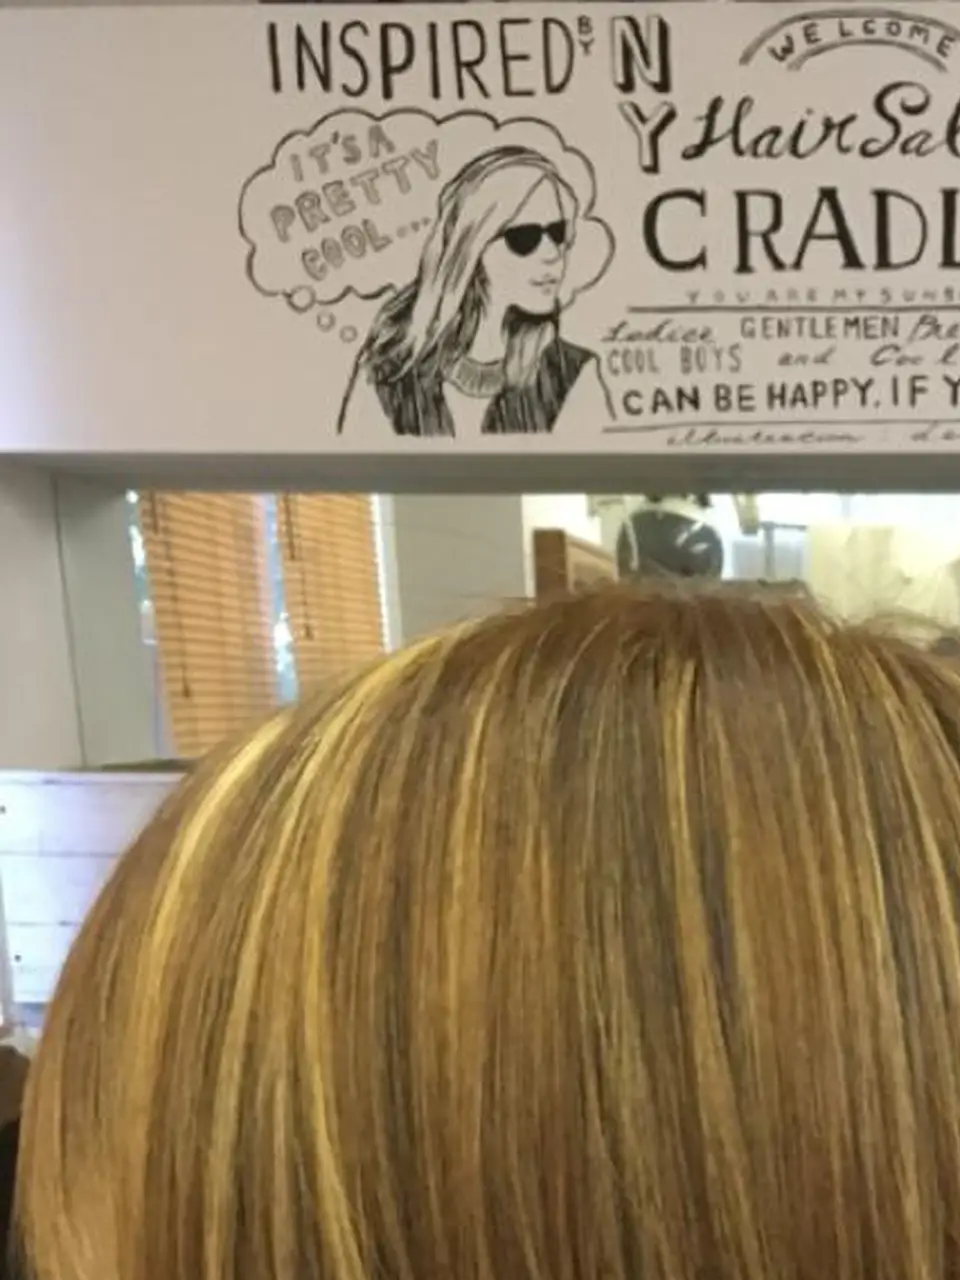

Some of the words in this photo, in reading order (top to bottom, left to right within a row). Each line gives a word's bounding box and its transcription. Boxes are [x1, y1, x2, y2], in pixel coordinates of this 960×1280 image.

[268, 18, 575, 101] INSPIRED
[767, 18, 957, 63] WELCOME
[681, 95, 858, 160] Hair
[290, 130, 362, 182] IT'S
[368, 124, 396, 159] A
[270, 139, 441, 243] PRETTY
[686, 289, 751, 304] YOU
[765, 288, 818, 303] ARE
[740, 315, 900, 340] GENTLEMEN
[606, 347, 660, 376] COOL
[680, 343, 743, 376] BOYS
[777, 345, 837, 367] and
[622, 383, 702, 417] CAN
[713, 382, 758, 413] BE
[891, 373, 931, 408] IF
